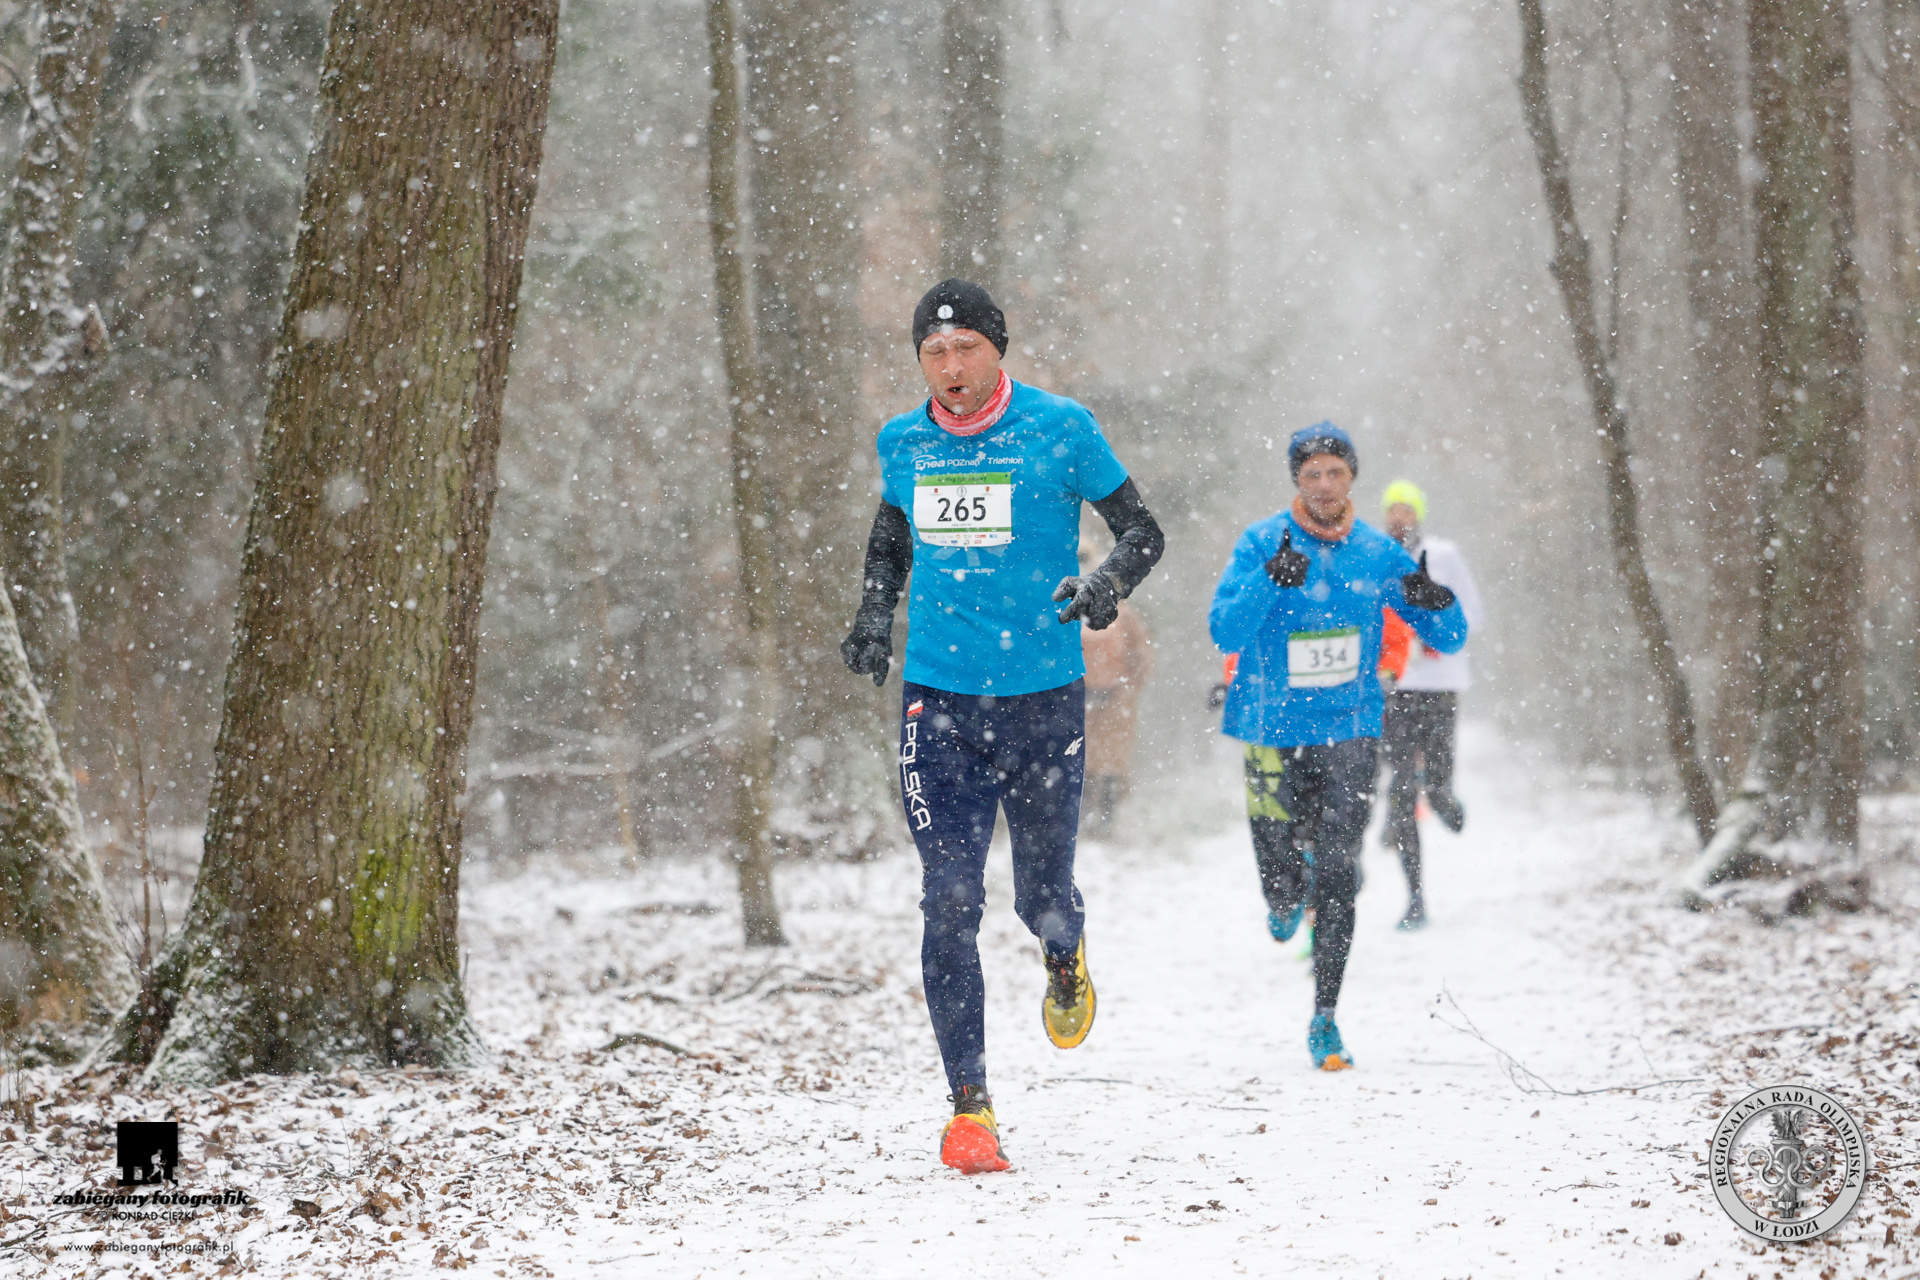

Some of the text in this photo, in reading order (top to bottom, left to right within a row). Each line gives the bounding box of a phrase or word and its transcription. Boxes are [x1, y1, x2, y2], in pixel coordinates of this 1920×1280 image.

[987, 457, 1024, 465] Triathlon
[937, 497, 986, 522] 265
[1309, 648, 1347, 669] 354
[903, 721, 932, 831] POLSKA
